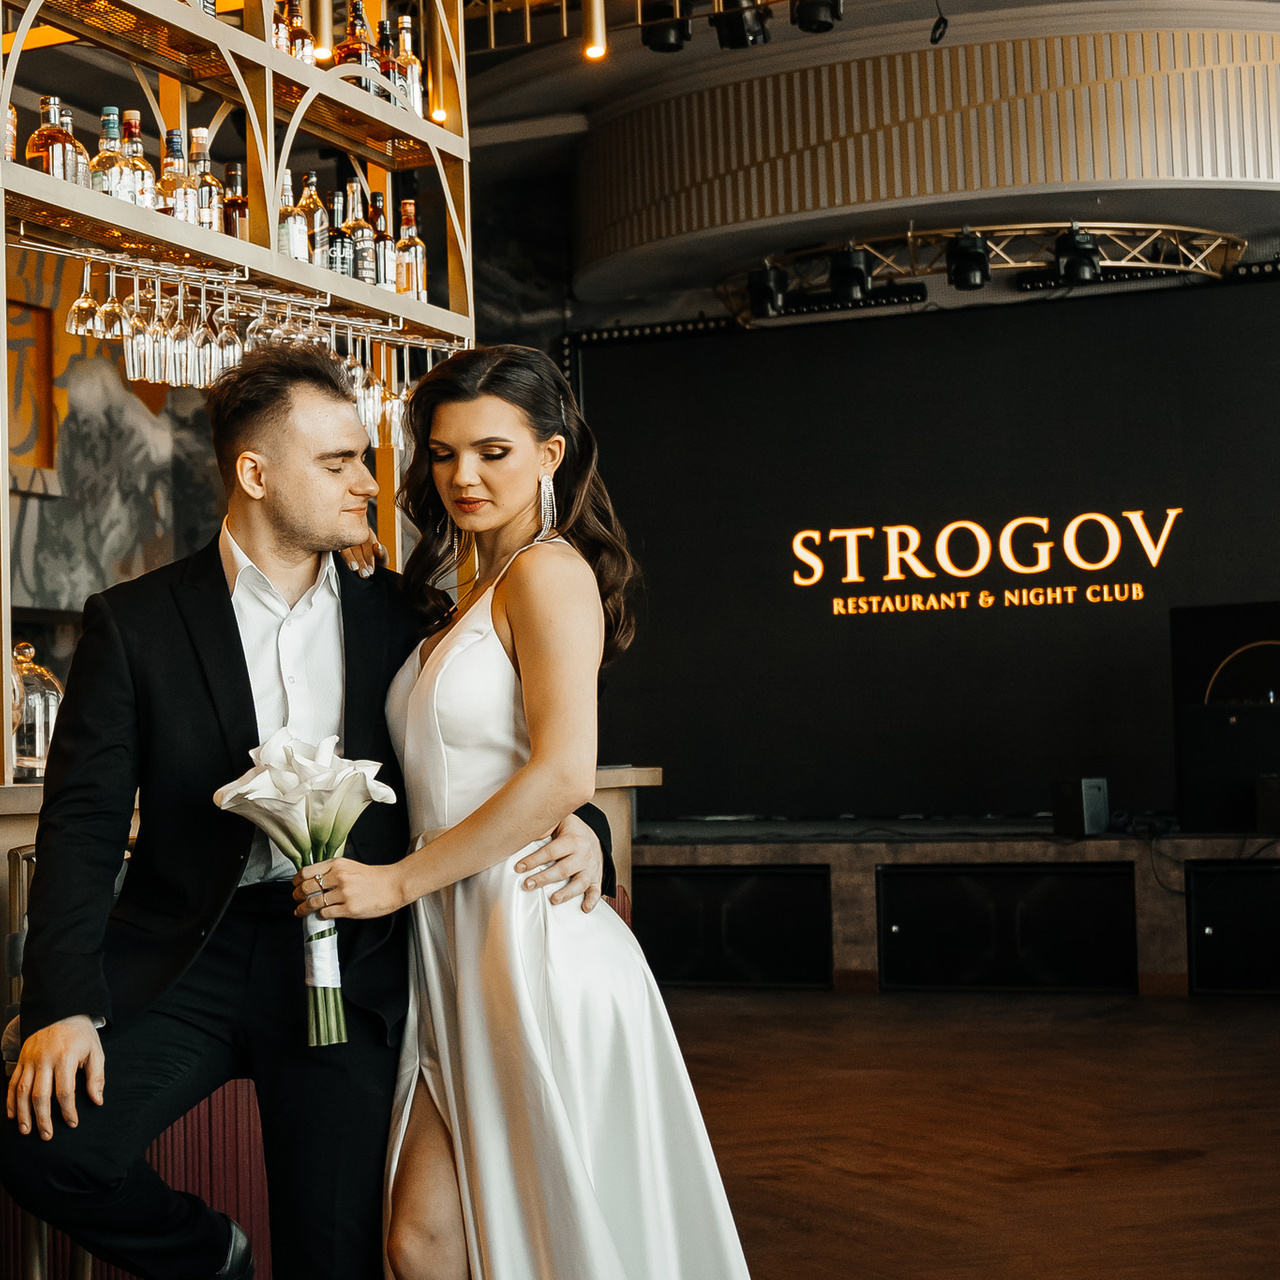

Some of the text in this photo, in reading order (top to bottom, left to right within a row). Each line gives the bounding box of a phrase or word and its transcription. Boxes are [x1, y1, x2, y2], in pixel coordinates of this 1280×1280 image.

[792, 508, 1183, 587] STROGOV
[832, 583, 1145, 615] RESTAURANT & NIGHT CLUB
